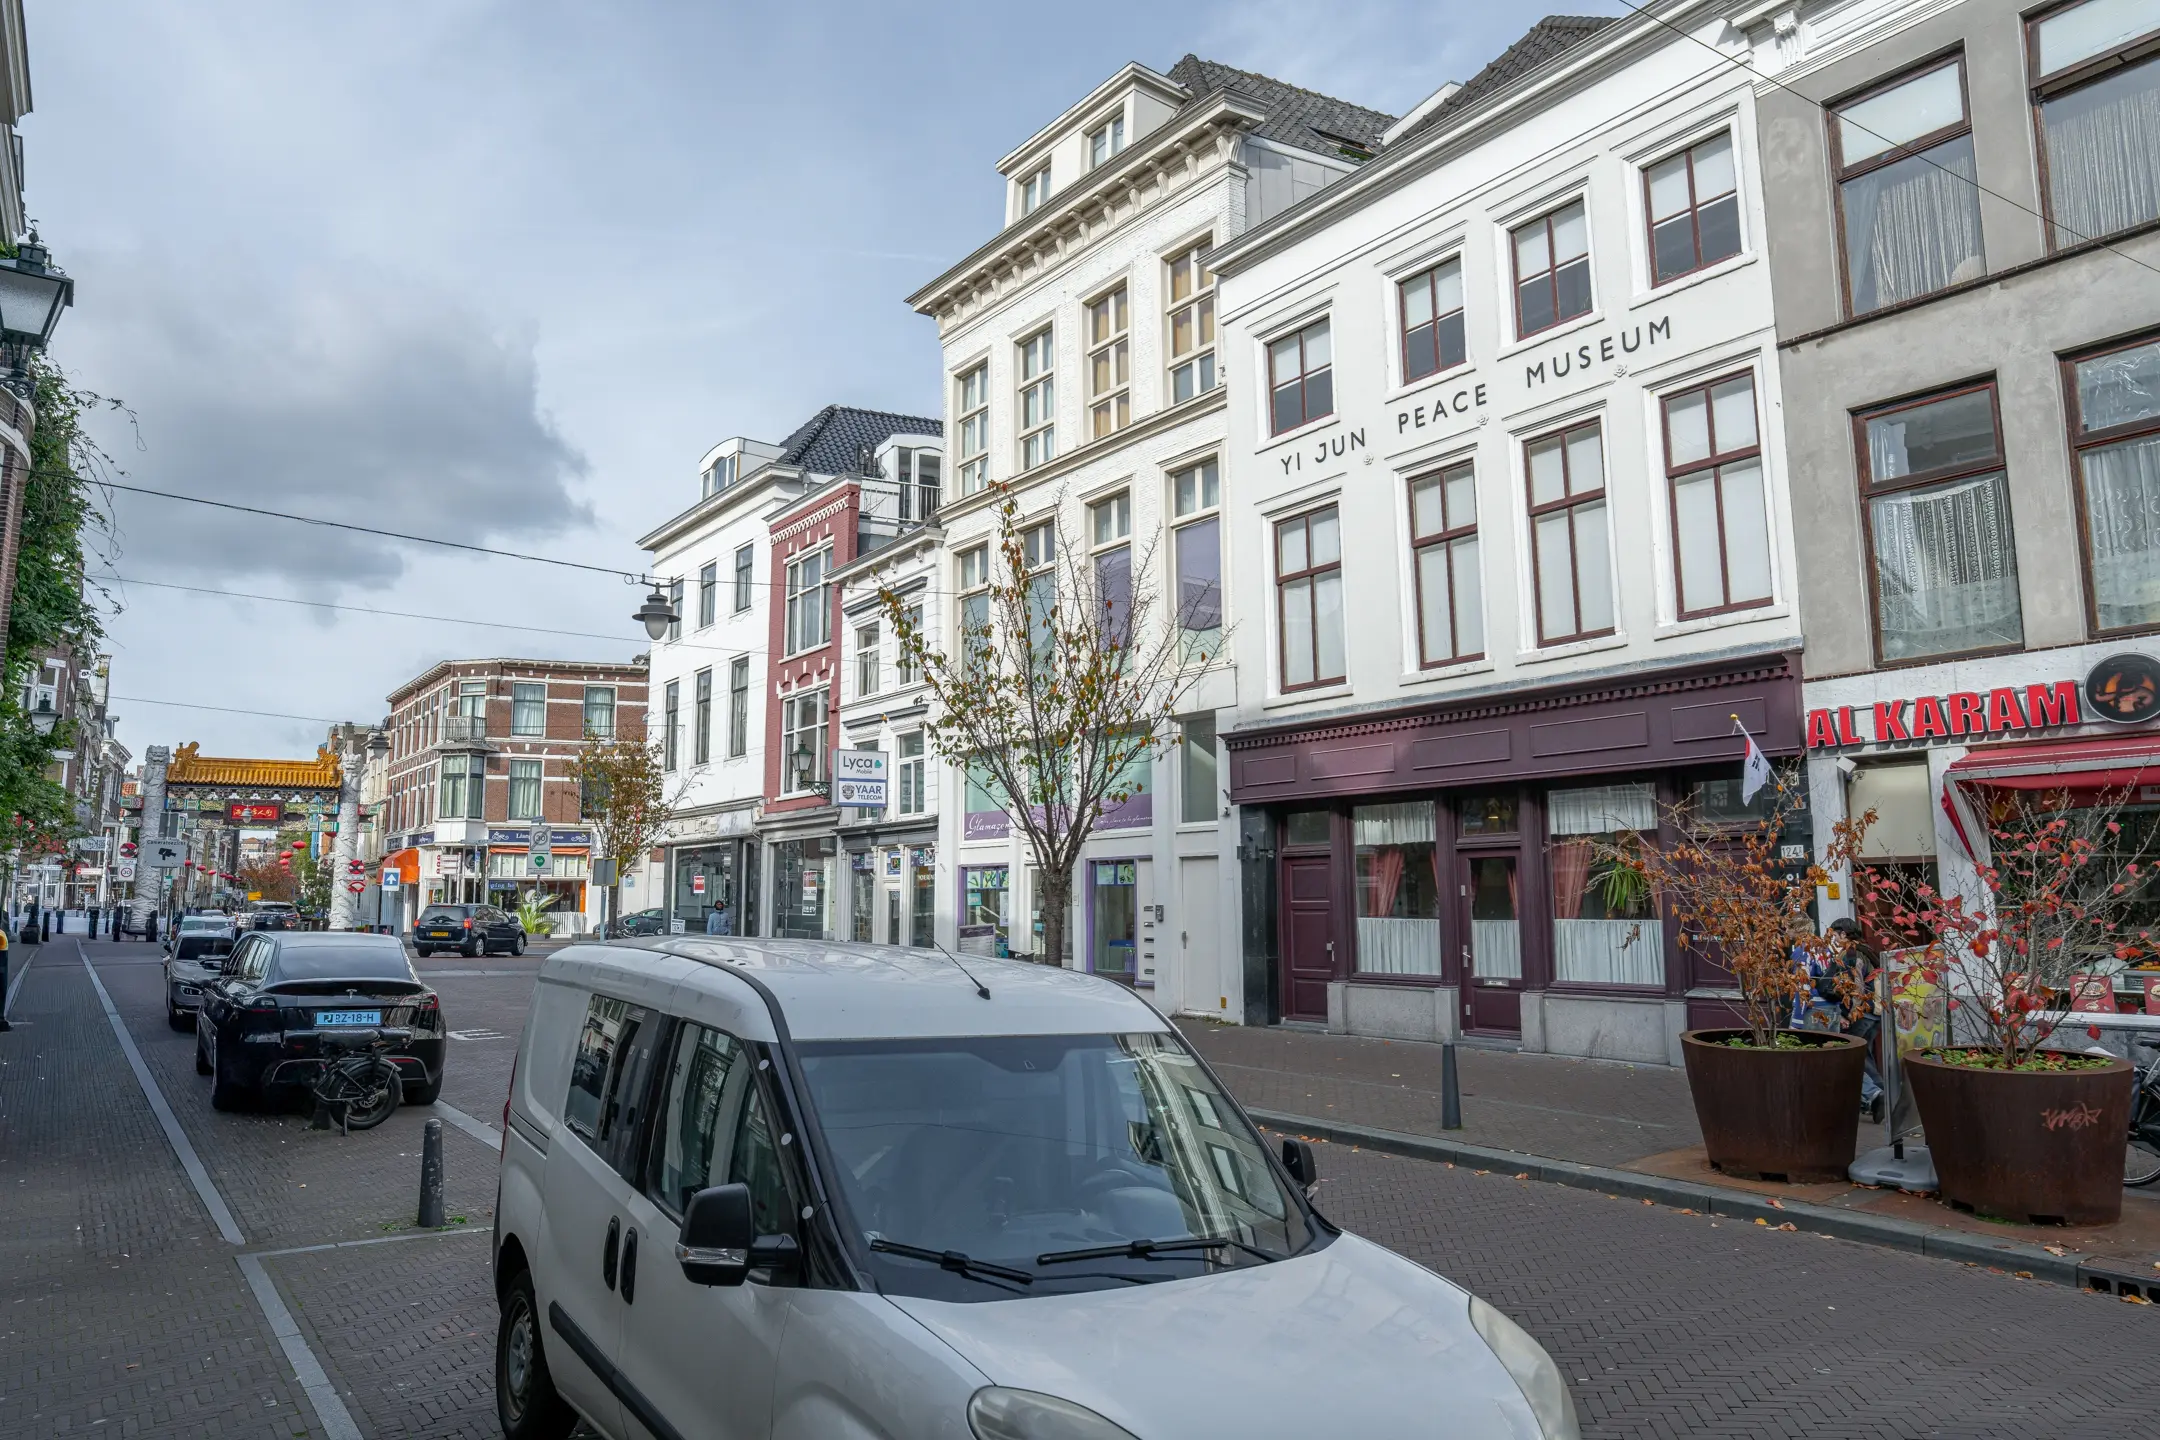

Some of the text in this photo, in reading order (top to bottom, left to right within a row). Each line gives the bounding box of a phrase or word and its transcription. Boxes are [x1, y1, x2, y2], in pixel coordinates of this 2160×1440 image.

[1280, 315, 1672, 475] YI JUN PEACE MUSEUM
[1807, 680, 2082, 748] AL KARAM
[843, 756, 873, 770] Lyca
[855, 785, 882, 794] YAAR
